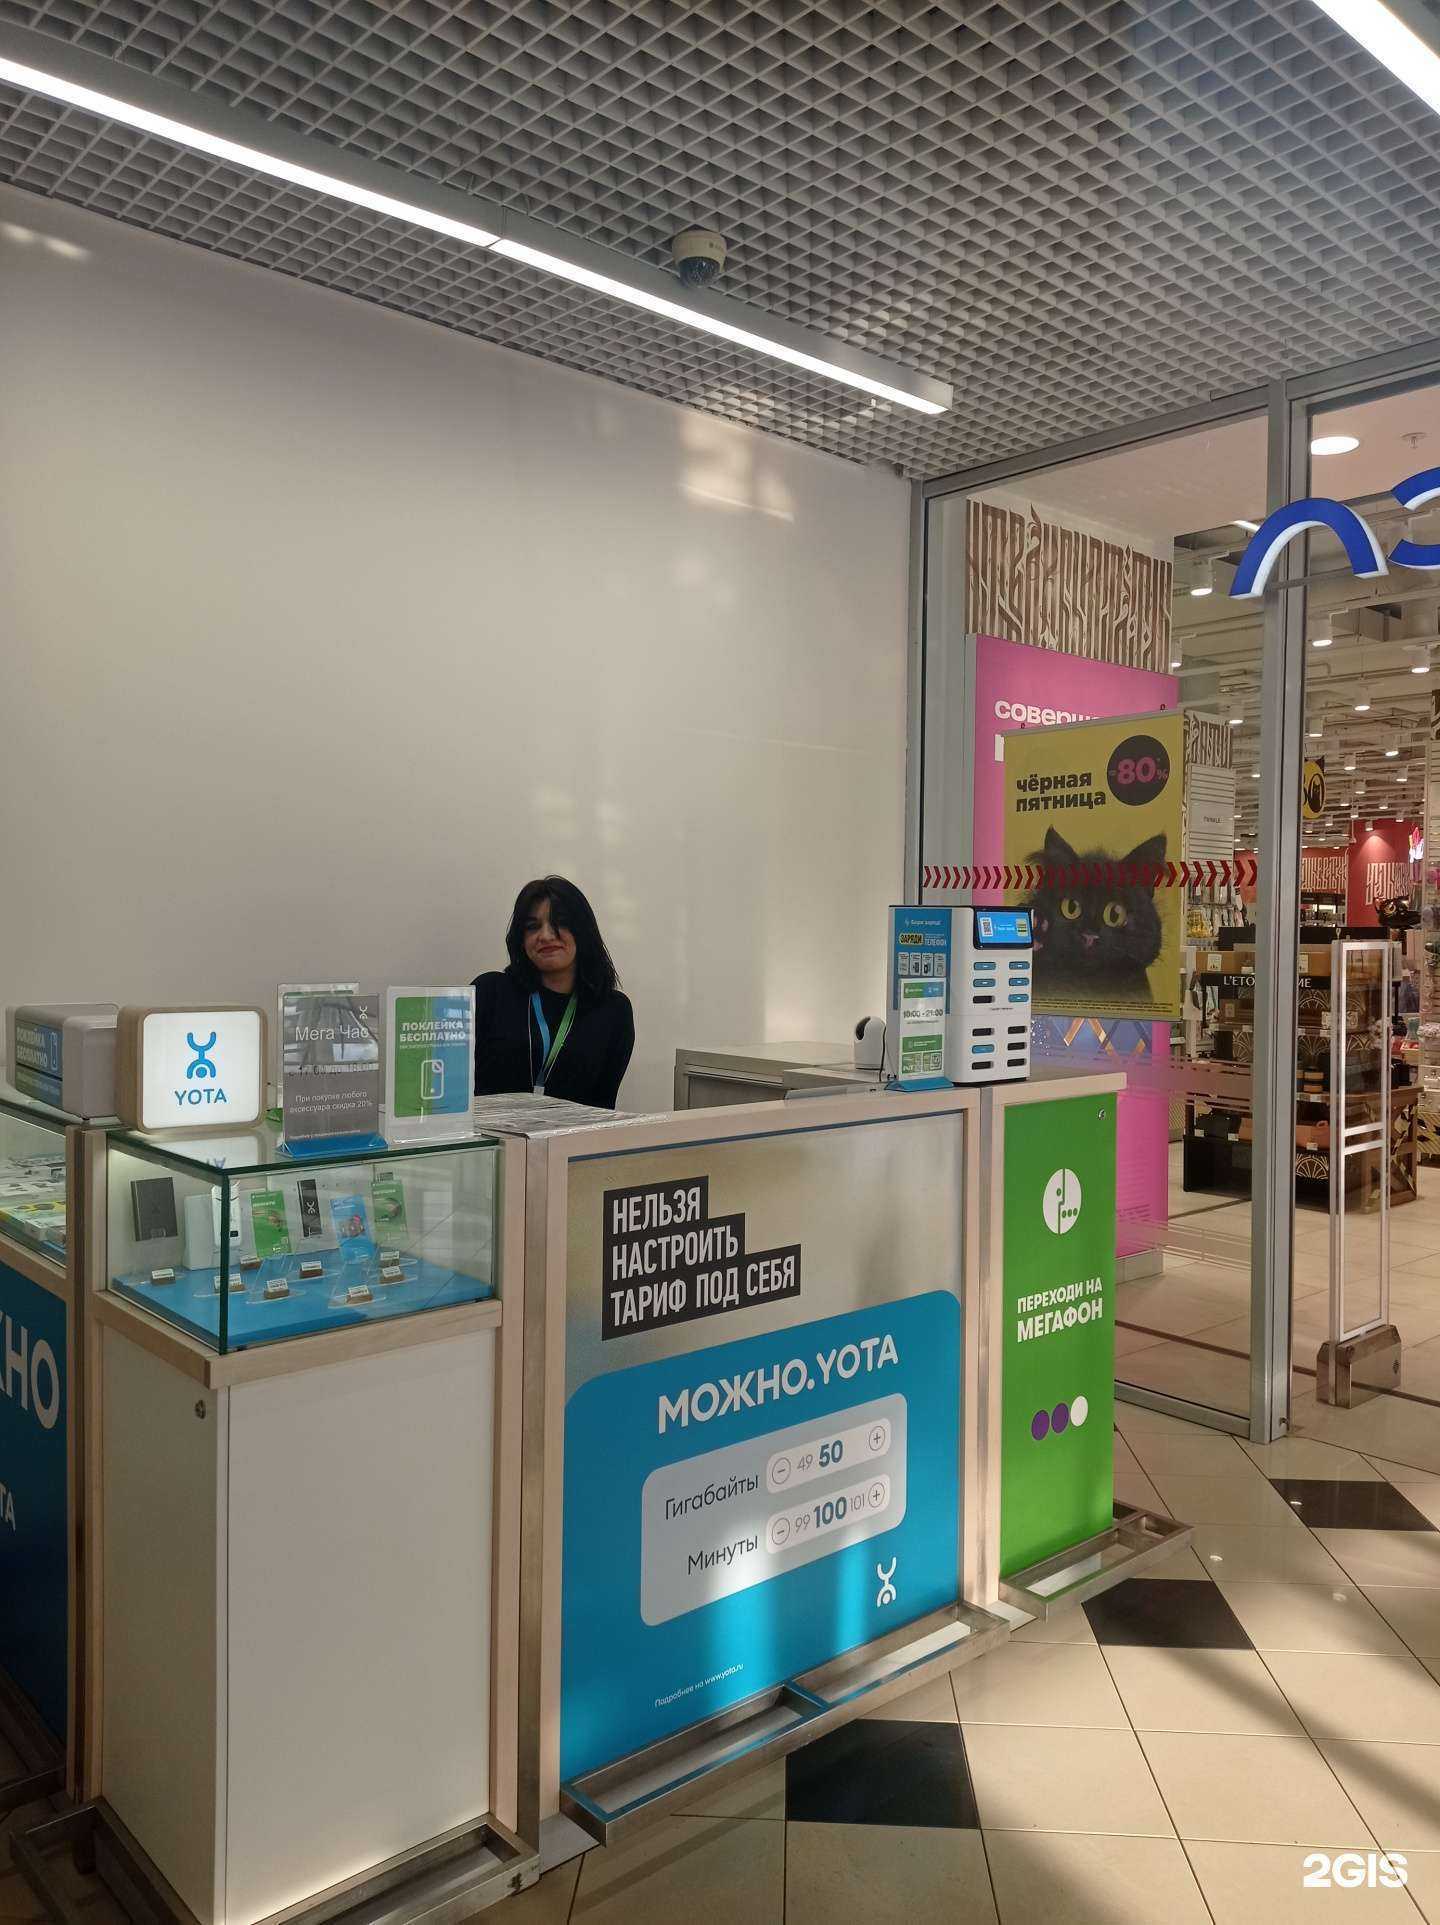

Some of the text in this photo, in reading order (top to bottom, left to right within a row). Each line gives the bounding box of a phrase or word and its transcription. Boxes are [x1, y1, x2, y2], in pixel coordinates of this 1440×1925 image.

[994, 700, 1102, 726] совер
[1016, 772, 1092, 795] чёрная
[1016, 789, 1106, 812] пятница
[1223, 975, 1256, 986] L'ETO
[295, 1024, 370, 1042] Мега Час
[400, 1032, 466, 1043] БЕСПЛАТНО
[402, 1019, 464, 1031] ПОКЛЕЙКА
[174, 1088, 227, 1106] YOTA
[289, 1104, 331, 1113] аксессуара
[332, 1102, 356, 1110] скидка
[295, 1090, 367, 1103] При покупке любого
[612, 1186, 701, 1235] НЕЛЬЗЯ
[611, 1225, 739, 1281] НАСТРОИТЬ
[610, 1255, 796, 1327] ТАРИФ ПОД СЕБЯ
[1017, 1277, 1103, 1314] ПЕРЕХОДИ НА
[1017, 1297, 1103, 1343] МЕГАФОН
[0, 1310, 60, 1430] НО
[664, 1439, 844, 1521] Гигабайты 49 50
[687, 1493, 865, 1576] Минуты 99 100 101
[655, 1685, 694, 1708] Подробнее
[694, 1681, 704, 1690] на
